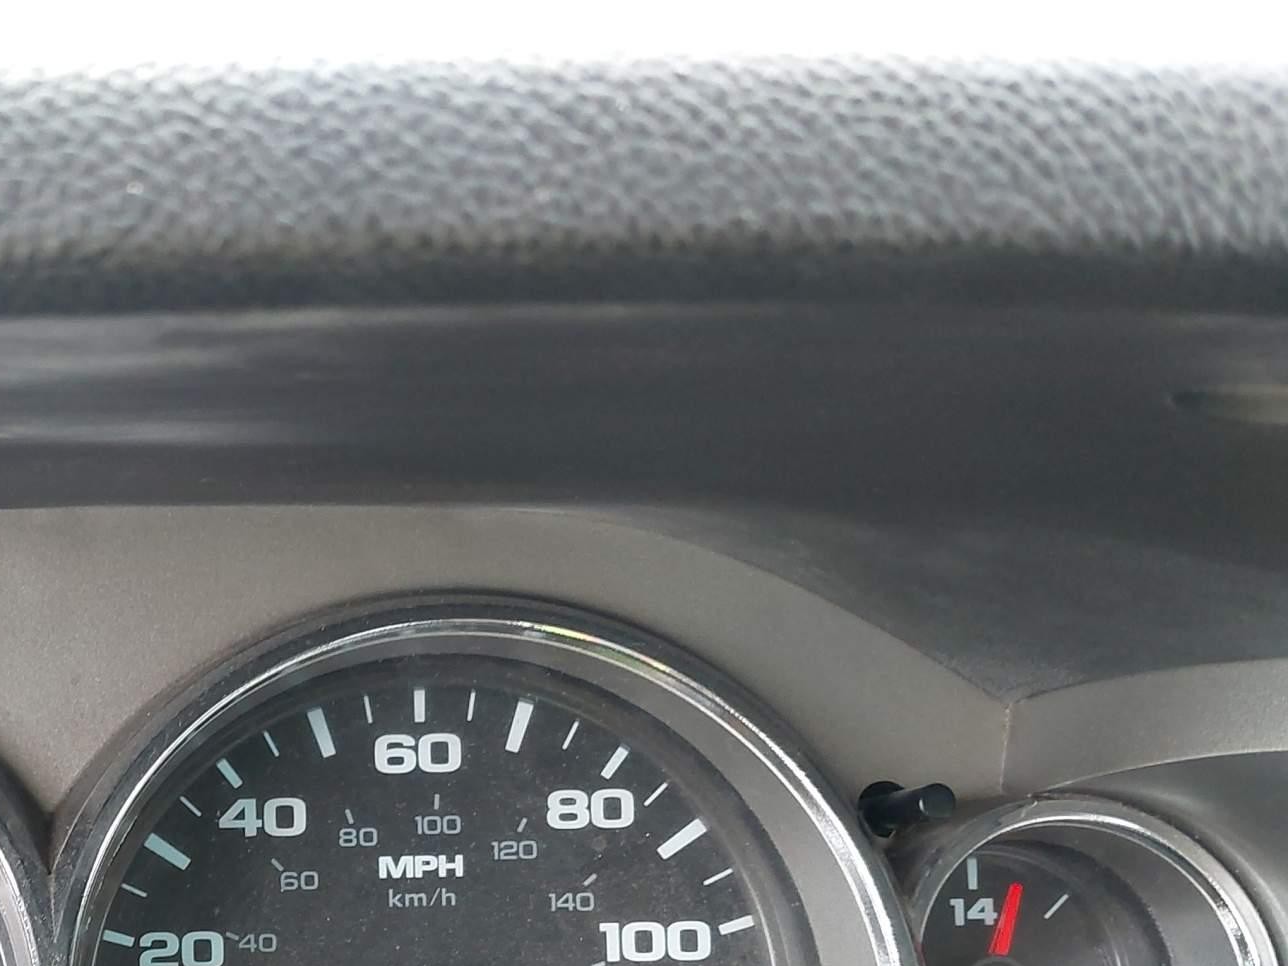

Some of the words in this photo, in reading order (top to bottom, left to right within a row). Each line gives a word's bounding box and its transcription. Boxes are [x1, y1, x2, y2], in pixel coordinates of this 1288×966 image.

[374, 733, 462, 774] 60
[219, 797, 307, 837] 40
[546, 788, 635, 829] 80
[414, 815, 462, 835] 100
[338, 828, 378, 847] 80
[491, 840, 538, 860] 120
[378, 855, 463, 879] MPH
[280, 871, 319, 891] 60
[388, 887, 457, 908] km/h
[548, 892, 594, 911] 140
[949, 898, 998, 926] 14
[238, 933, 277, 952] 40
[598, 920, 711, 962] 100
